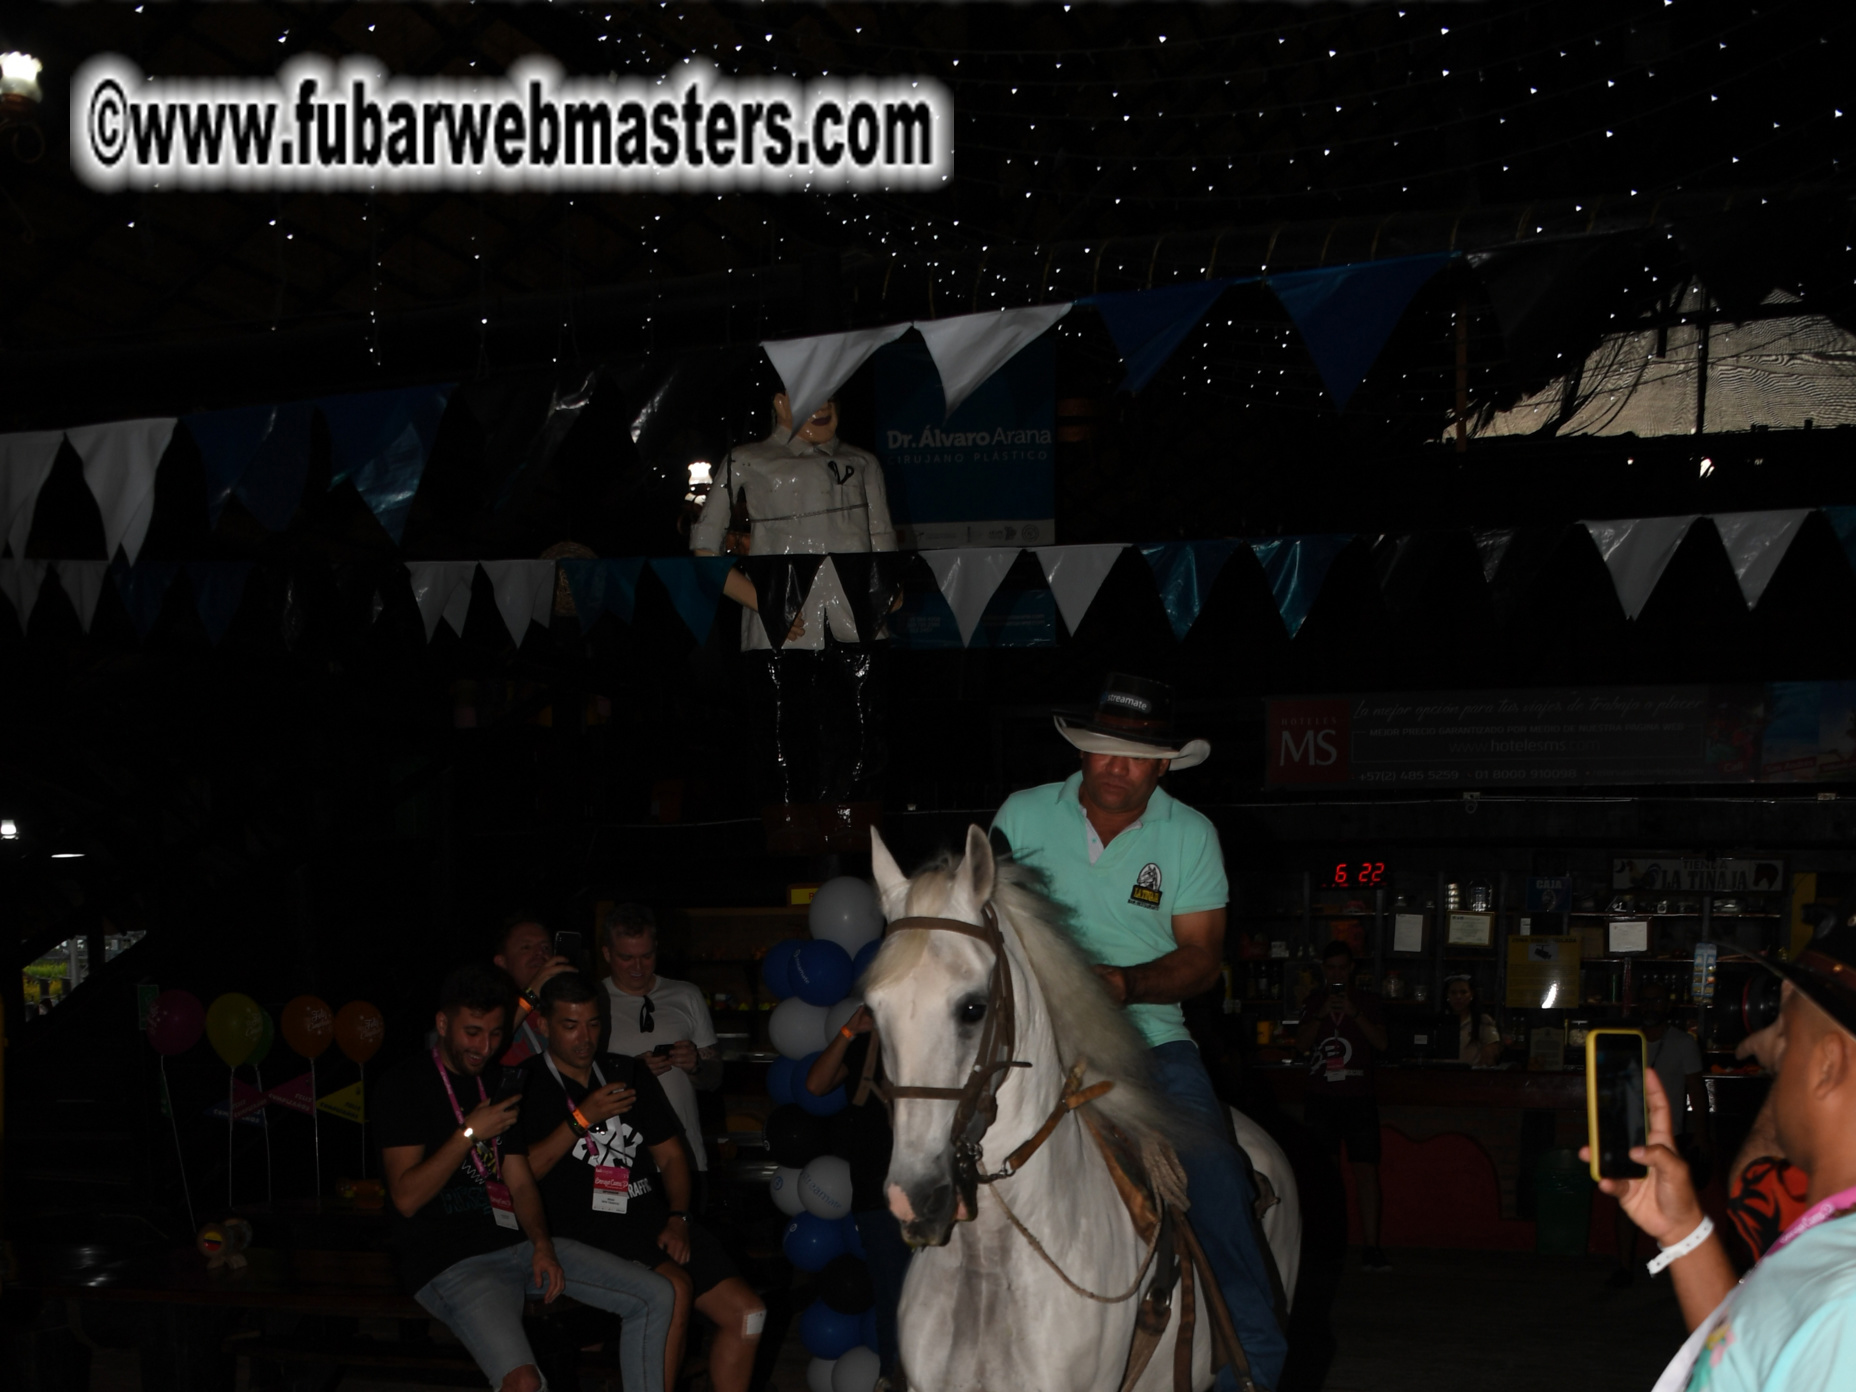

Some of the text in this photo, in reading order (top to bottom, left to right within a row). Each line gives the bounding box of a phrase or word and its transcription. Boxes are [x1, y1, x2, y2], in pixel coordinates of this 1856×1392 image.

[991, 426, 1053, 446] Arana
[886, 450, 1048, 465] CIRUJANO PLÁSTICO
[1372, 703, 1412, 722] mejor
[1458, 703, 1494, 721] para
[1566, 697, 1584, 712] de
[1281, 716, 1338, 726] HOTELES
[1369, 728, 1400, 737] MEJOR
[1402, 727, 1436, 736] PRECIO
[1438, 725, 1504, 736] GARANTIZADO
[1506, 725, 1527, 734] POR
[1529, 725, 1561, 734] MEDIO
[1562, 725, 1576, 733] DE
[1578, 724, 1622, 733] NUESTRA
[1662, 722, 1684, 732] WEB
[1279, 728, 1338, 767] MS
[1358, 770, 1396, 782] +57(2)
[1400, 770, 1424, 780] 485
[1427, 770, 1459, 780] 5259
[1475, 770, 1489, 780] 01
[1492, 769, 1526, 780] 8000
[1530, 768, 1577, 779] 910098
[1683, 860, 1729, 870] TIENDA
[1535, 879, 1562, 889] CAJA
[1661, 870, 1748, 890] LA TINAJA
